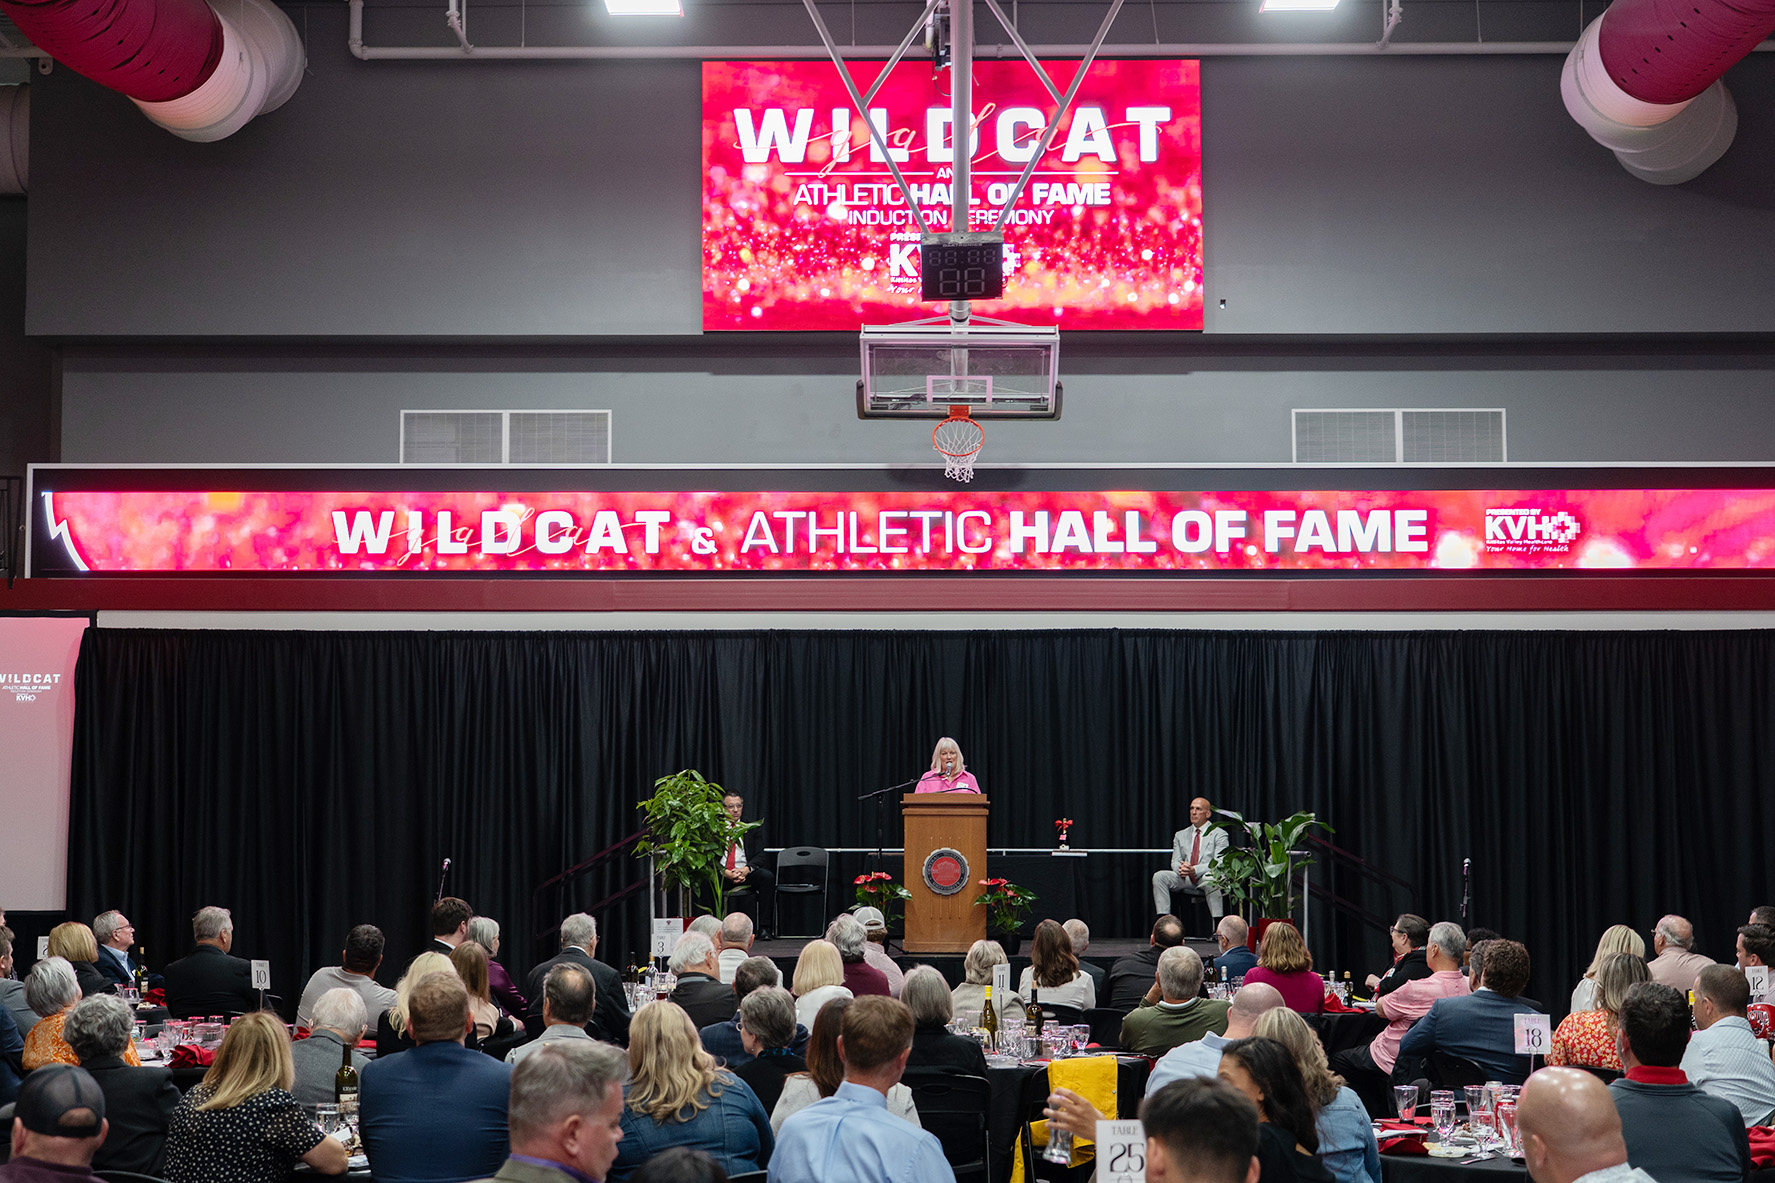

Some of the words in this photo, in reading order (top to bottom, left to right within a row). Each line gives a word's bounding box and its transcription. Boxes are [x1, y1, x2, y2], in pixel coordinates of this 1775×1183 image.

[734, 106, 1171, 163] WILDCAT
[936, 166, 954, 179] AN
[793, 183, 905, 206] ATHLETIC
[909, 183, 981, 206] HAL
[1032, 183, 1111, 206] FAME
[848, 209, 947, 226] INDUCTON
[968, 209, 1056, 226] EREMONY
[331, 510, 671, 554] WILDCAT
[690, 526, 718, 555] &
[740, 510, 992, 554] ATHLETIC
[1009, 510, 1157, 553] HALL
[1171, 509, 1248, 553] OF
[1264, 509, 1428, 553] FAME
[657, 941, 665, 953] 3
[256, 969, 267, 984] 10
[998, 974, 1005, 988] 11
[1752, 975, 1764, 990] 12
[1525, 1028, 1542, 1048] 18
[1112, 1125, 1140, 1136] TABLE
[1110, 1142, 1145, 1173] 25
